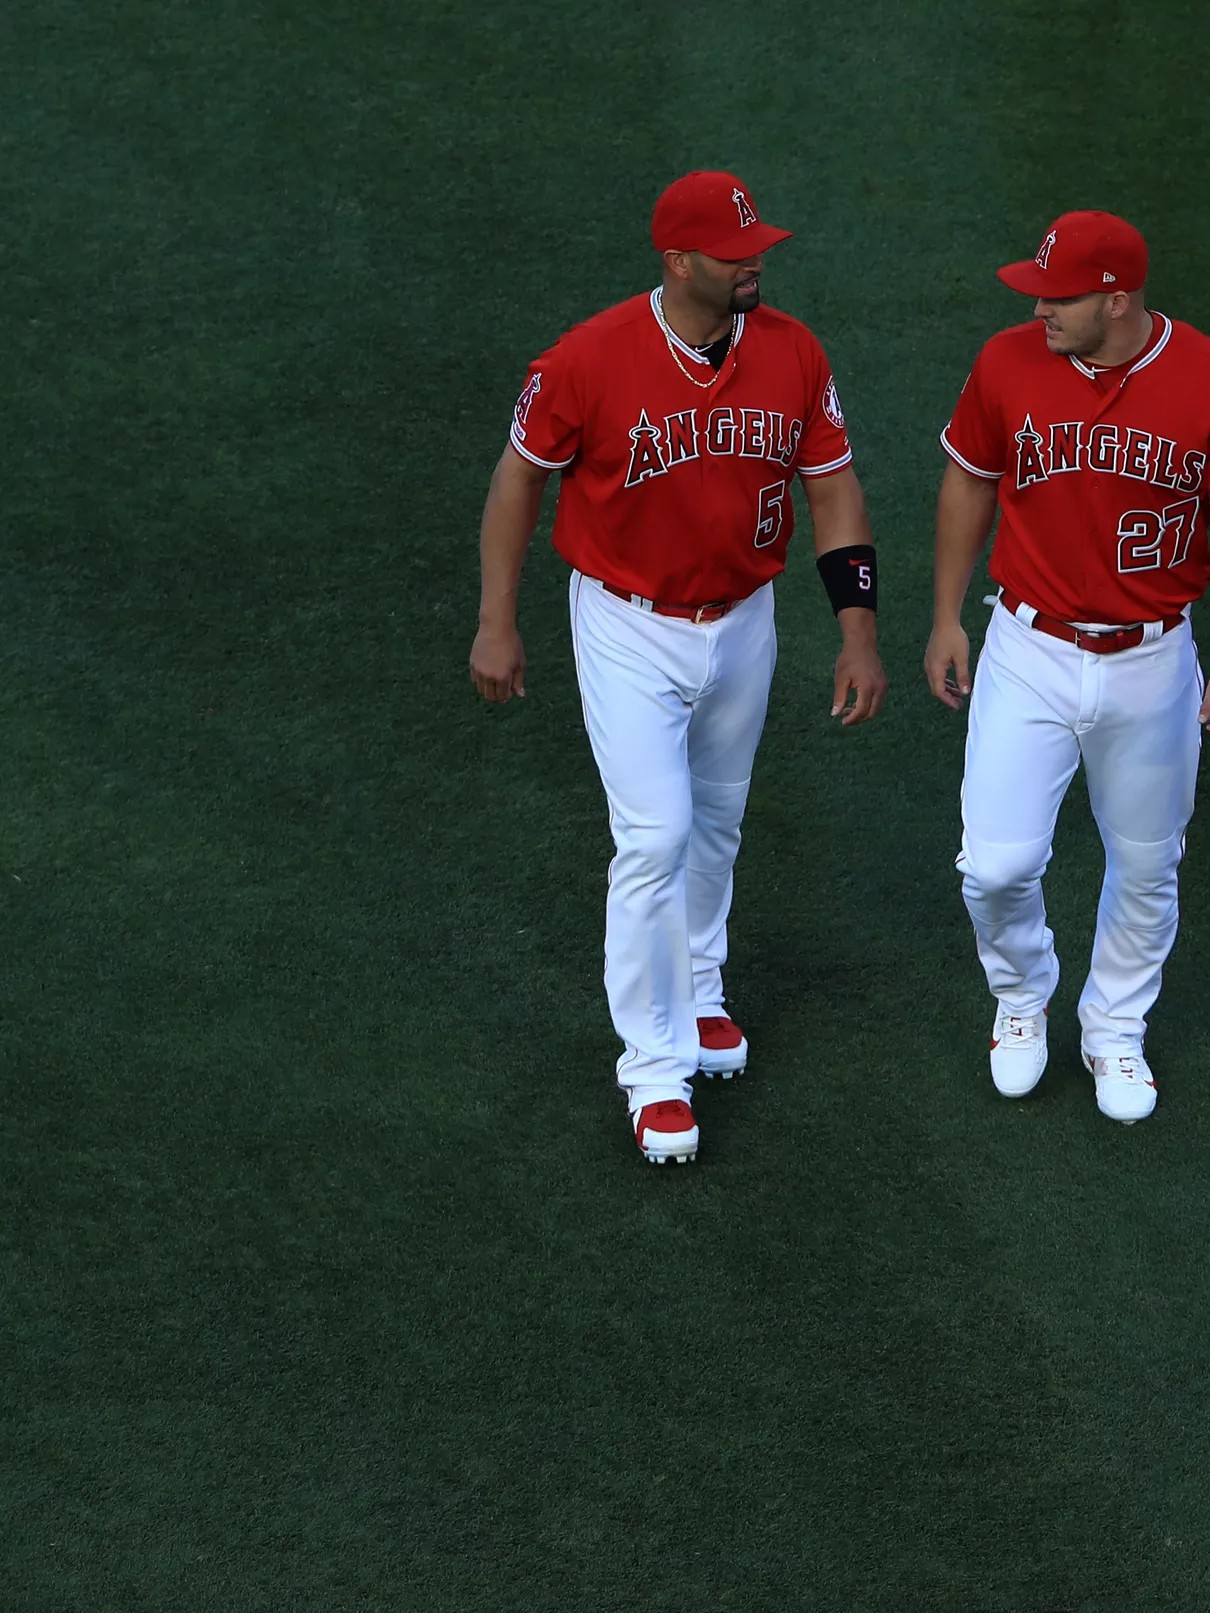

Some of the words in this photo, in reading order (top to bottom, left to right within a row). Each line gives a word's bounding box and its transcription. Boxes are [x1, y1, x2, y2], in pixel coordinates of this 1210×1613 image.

[732, 187, 756, 228] A
[1035, 230, 1056, 269] A
[624, 408, 802, 488] ANGELS
[1015, 413, 1206, 492] ANGELS
[754, 479, 785, 548] 5
[1117, 495, 1199, 573] 27
[859, 566, 871, 590] 5
